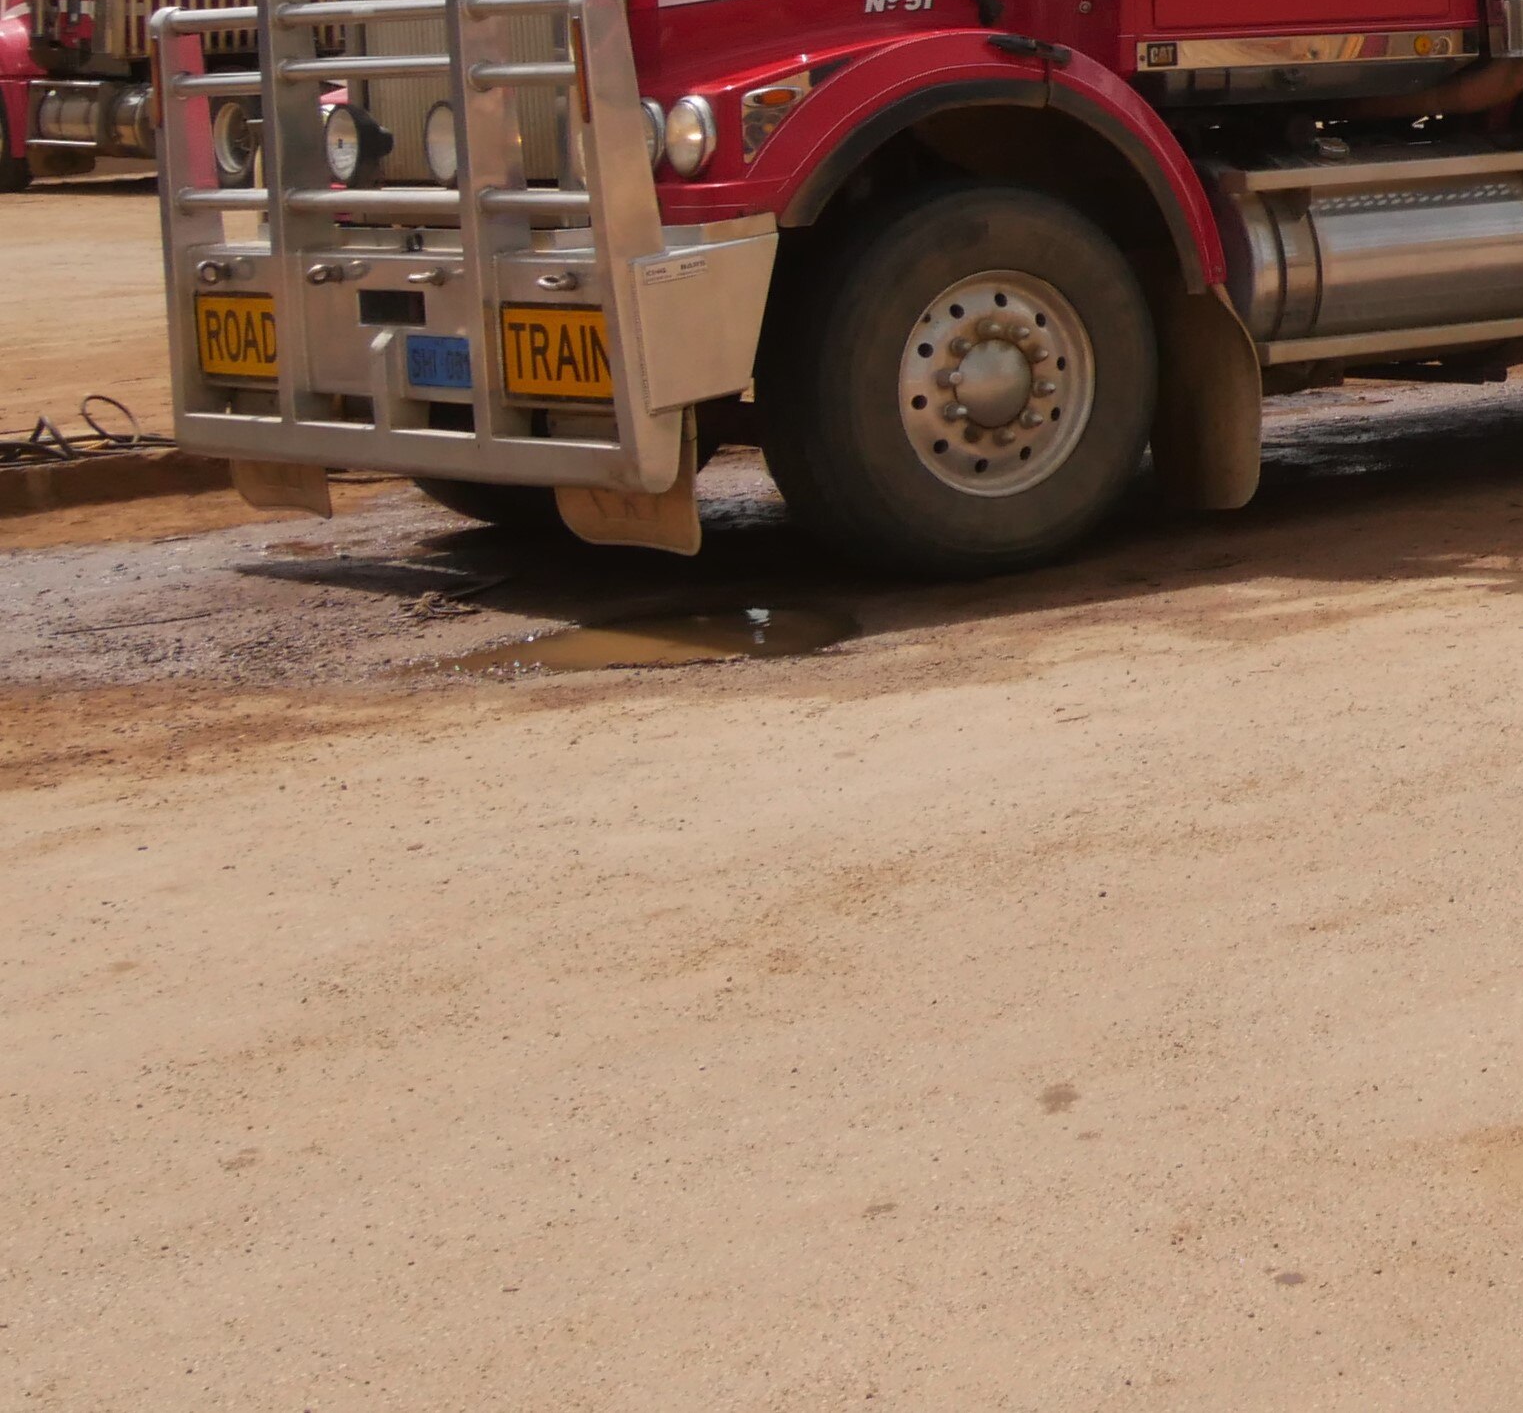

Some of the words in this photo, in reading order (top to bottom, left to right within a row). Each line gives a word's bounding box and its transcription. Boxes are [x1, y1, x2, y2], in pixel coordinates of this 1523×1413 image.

[1151, 46, 1174, 63] CAT
[205, 309, 277, 364] ROAD
[508, 322, 613, 383] TRAIN
